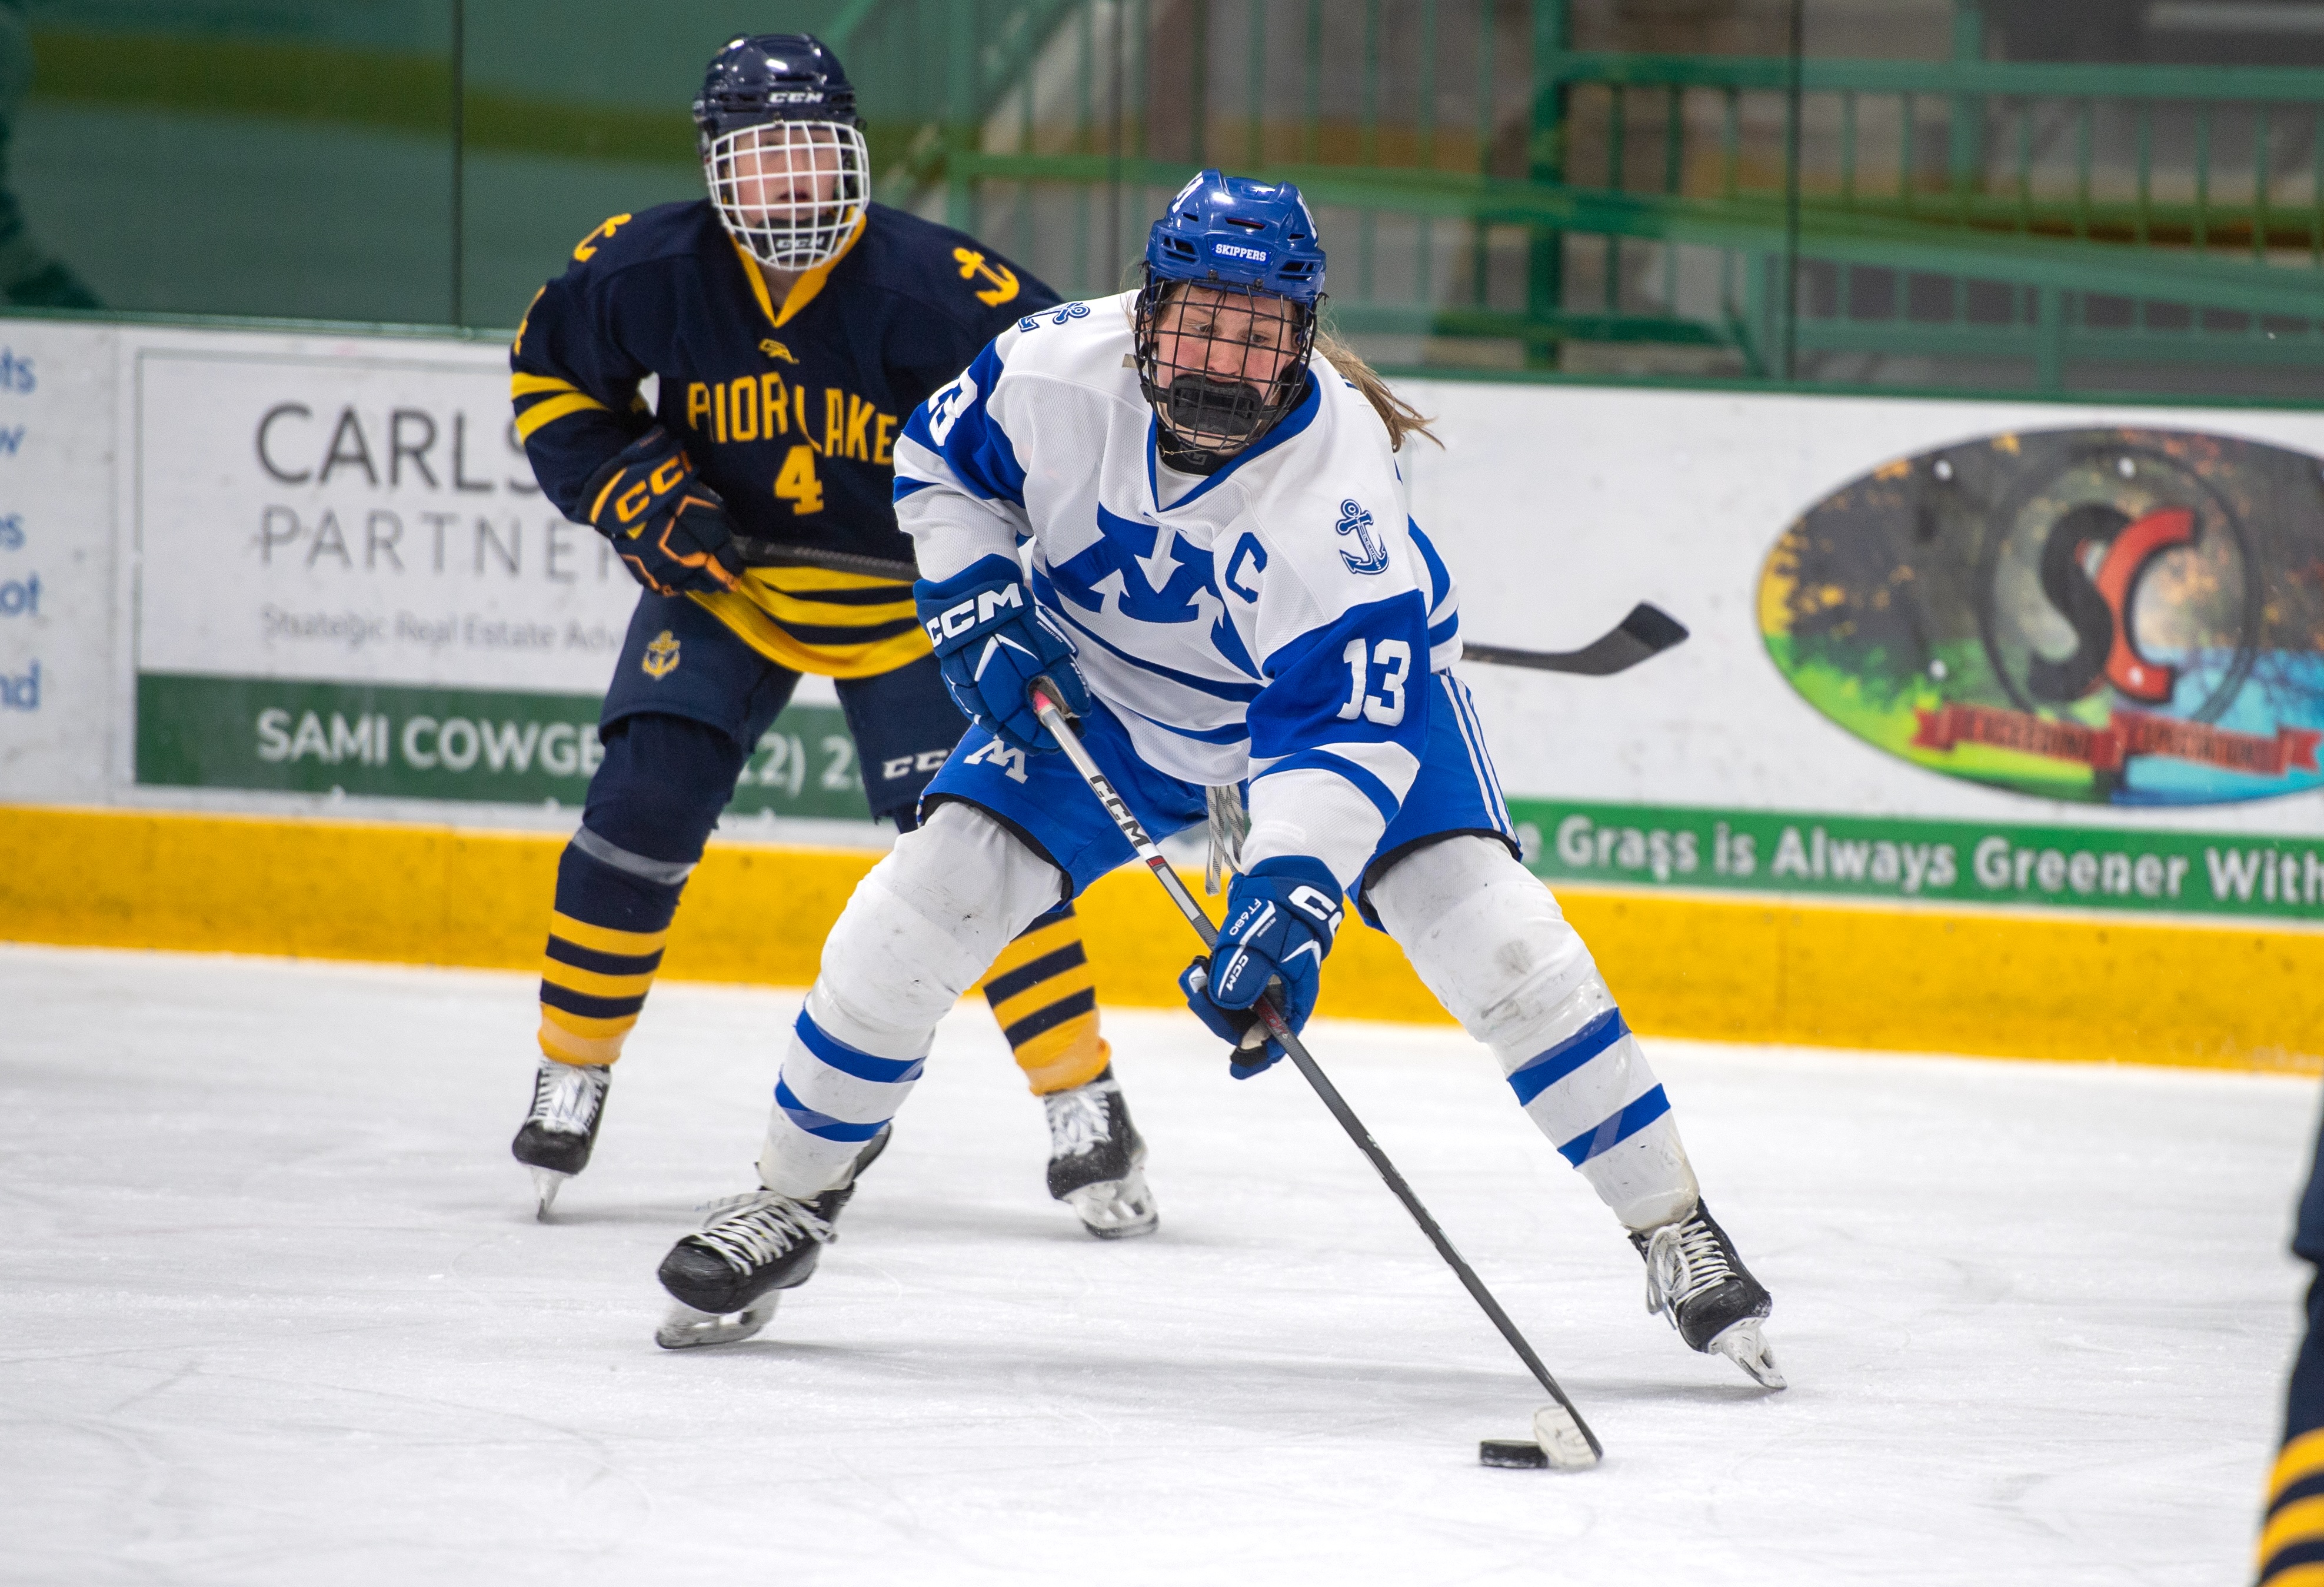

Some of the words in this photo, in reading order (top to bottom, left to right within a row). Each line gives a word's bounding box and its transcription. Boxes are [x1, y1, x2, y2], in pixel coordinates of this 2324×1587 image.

[769, 91, 823, 104] CCM
[1214, 242, 1267, 262] SKIPPERS
[774, 444, 824, 515] 4
[1225, 531, 1268, 604] C
[927, 583, 1023, 648] CCM
[1336, 638, 1412, 727] 13
[257, 708, 388, 764] SAMI
[883, 749, 954, 780] CC
[1090, 774, 1151, 848] CCM
[1556, 814, 1699, 872] Grass
[1714, 821, 1757, 876] is
[1771, 825, 1958, 893] Always
[1973, 827, 2189, 898] Greener
[1229, 898, 1262, 936] FT680
[1226, 954, 1249, 992] CCM
